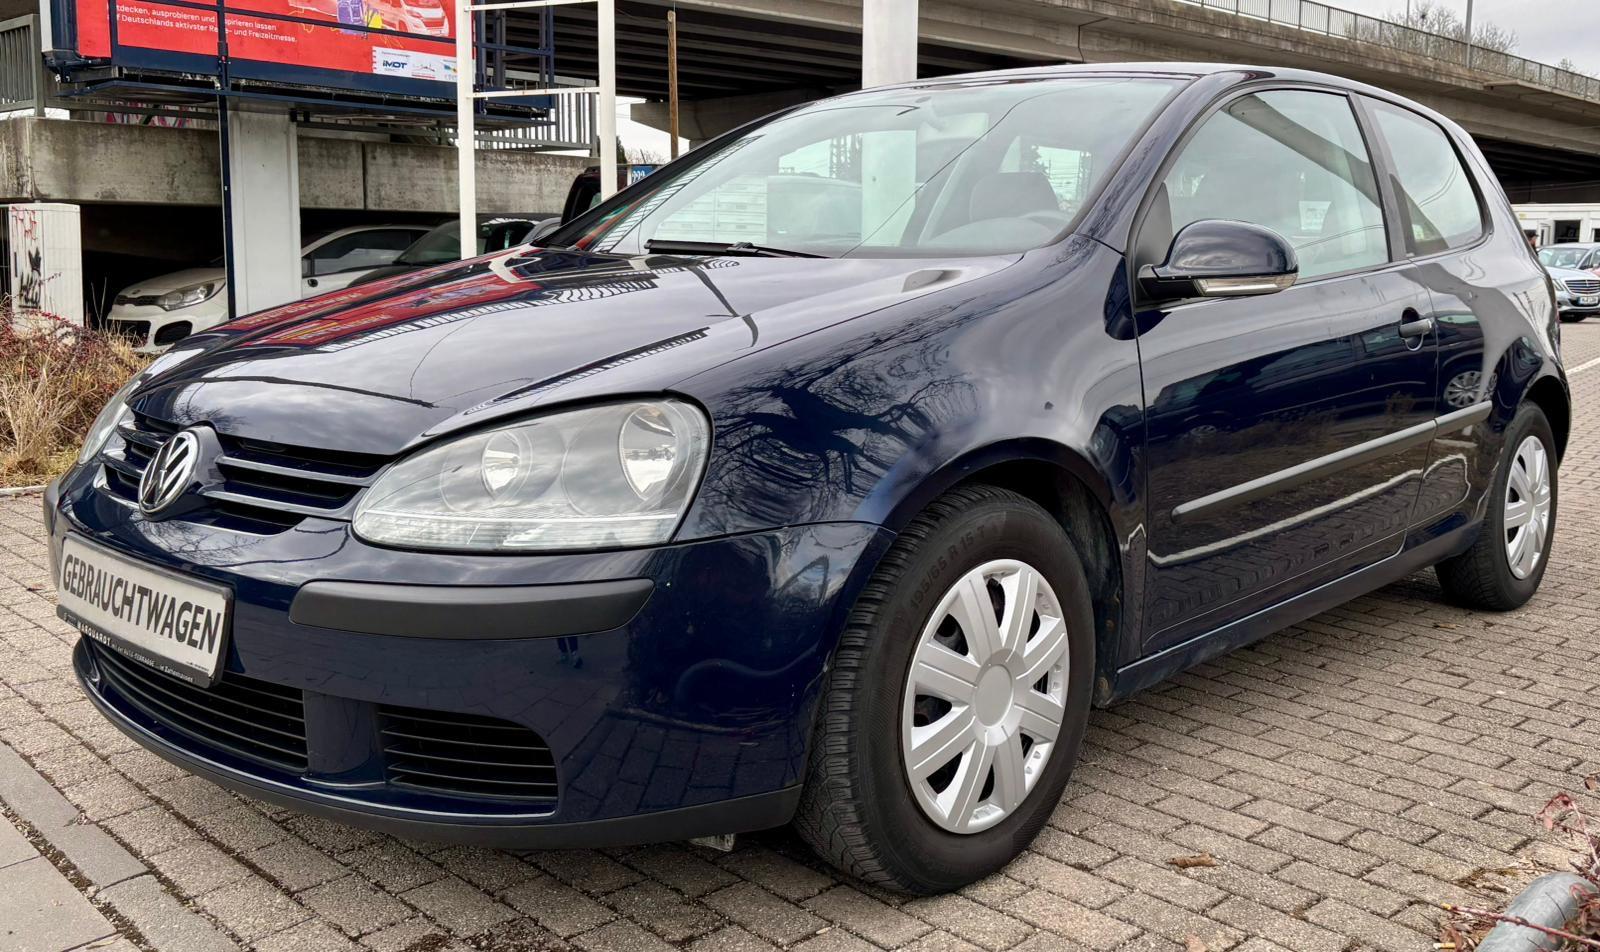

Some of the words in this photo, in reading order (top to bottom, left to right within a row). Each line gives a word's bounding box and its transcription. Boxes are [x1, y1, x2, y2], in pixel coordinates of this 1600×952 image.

[107, 2, 150, 15] tdecken,
[152, 9, 200, 21] ausprobieren
[201, 15, 215, 23] und
[254, 21, 277, 31] lassen
[122, 14, 174, 27] Deutschlands
[175, 21, 208, 31] aktivster
[209, 25, 232, 34] Ree-
[233, 28, 247, 36] und
[248, 30, 298, 43] Freizeitmesse.
[63, 554, 222, 654] GEBRAUCHTWAGEN
